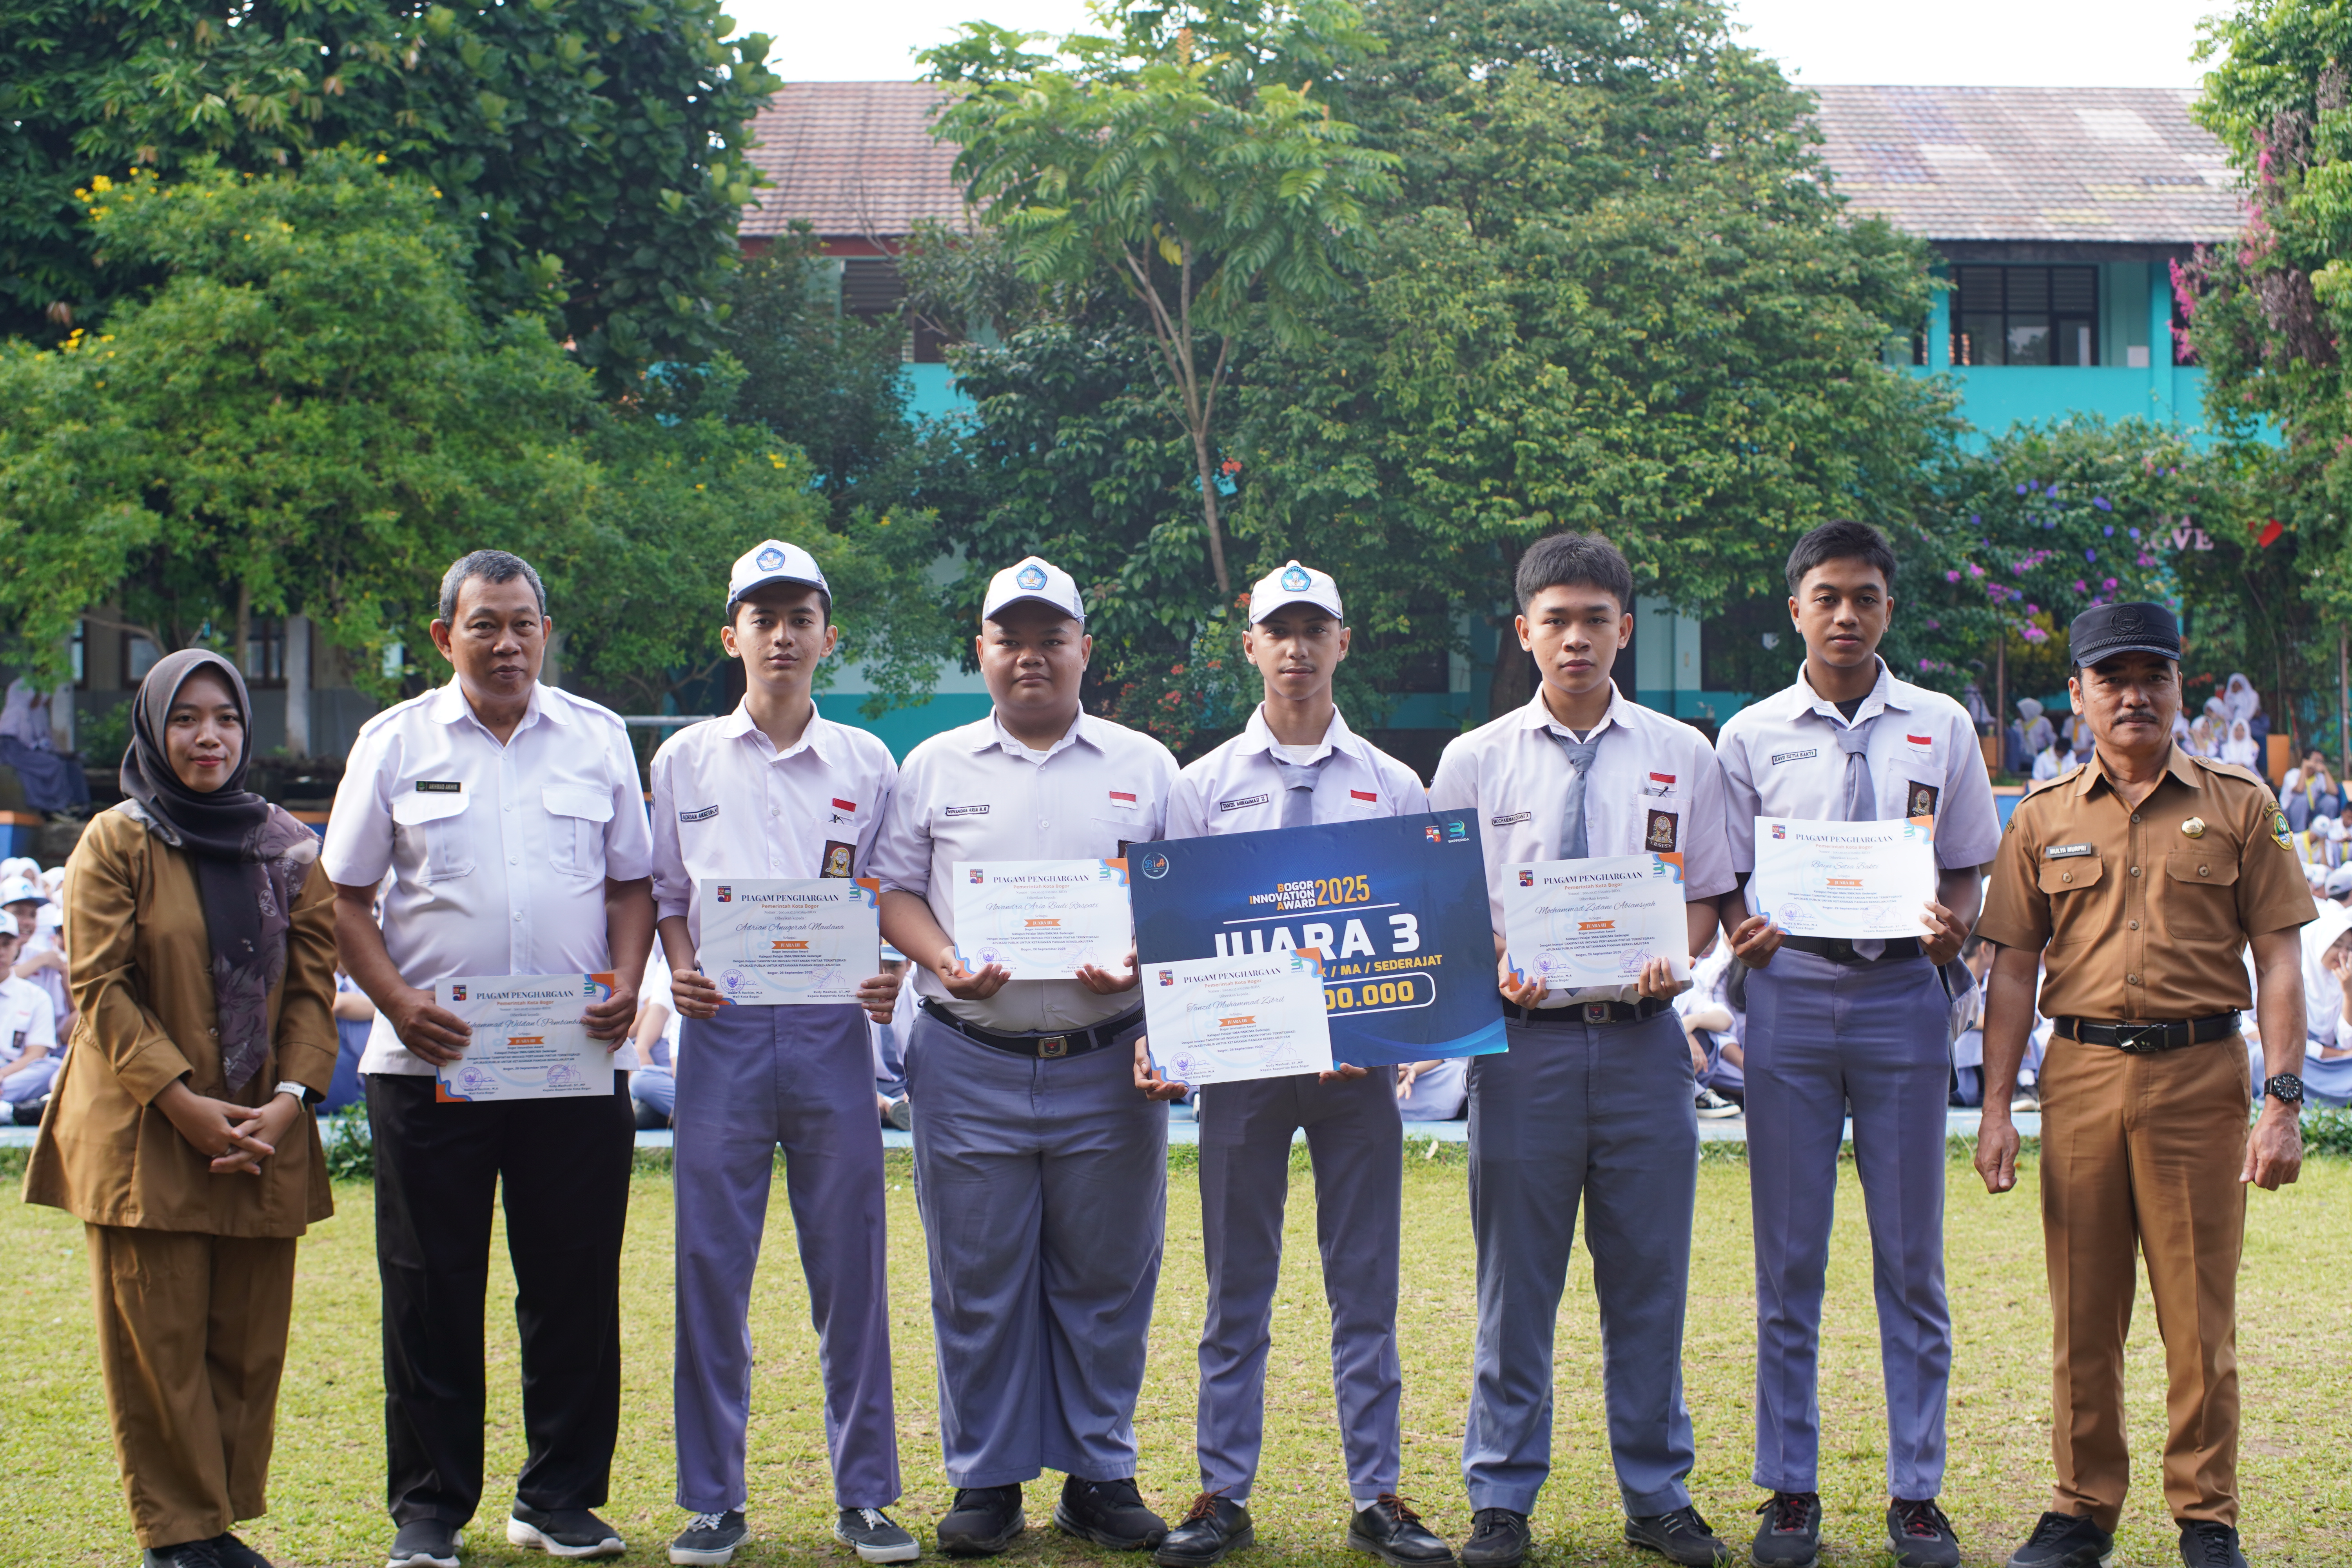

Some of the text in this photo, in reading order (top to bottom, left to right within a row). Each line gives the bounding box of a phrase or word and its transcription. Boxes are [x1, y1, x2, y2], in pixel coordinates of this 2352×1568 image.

[1811, 860, 1832, 870] Bayu
[1544, 871, 1642, 884] PIAGAM PENGHARGAAN
[1277, 880, 1314, 892] BOGOR
[1315, 875, 1370, 906] 2025
[1249, 889, 1315, 904] INNOVATION
[1277, 898, 1316, 911] AWARD
[1535, 900, 1656, 915] Mochammad Zidane Abiansyah
[736, 923, 844, 933] Adrian Anugerah Maulana
[1214, 913, 1420, 960] JUARA 3
[1331, 966, 1336, 977] /
[1341, 964, 1361, 975] MA
[1365, 962, 1370, 974] /
[1374, 955, 1442, 971] SEDERAJAT
[1184, 967, 1281, 983] PIAGAM PENGHARGAAN
[1186, 995, 1285, 1013] Tanzil Muhammad Zibril
